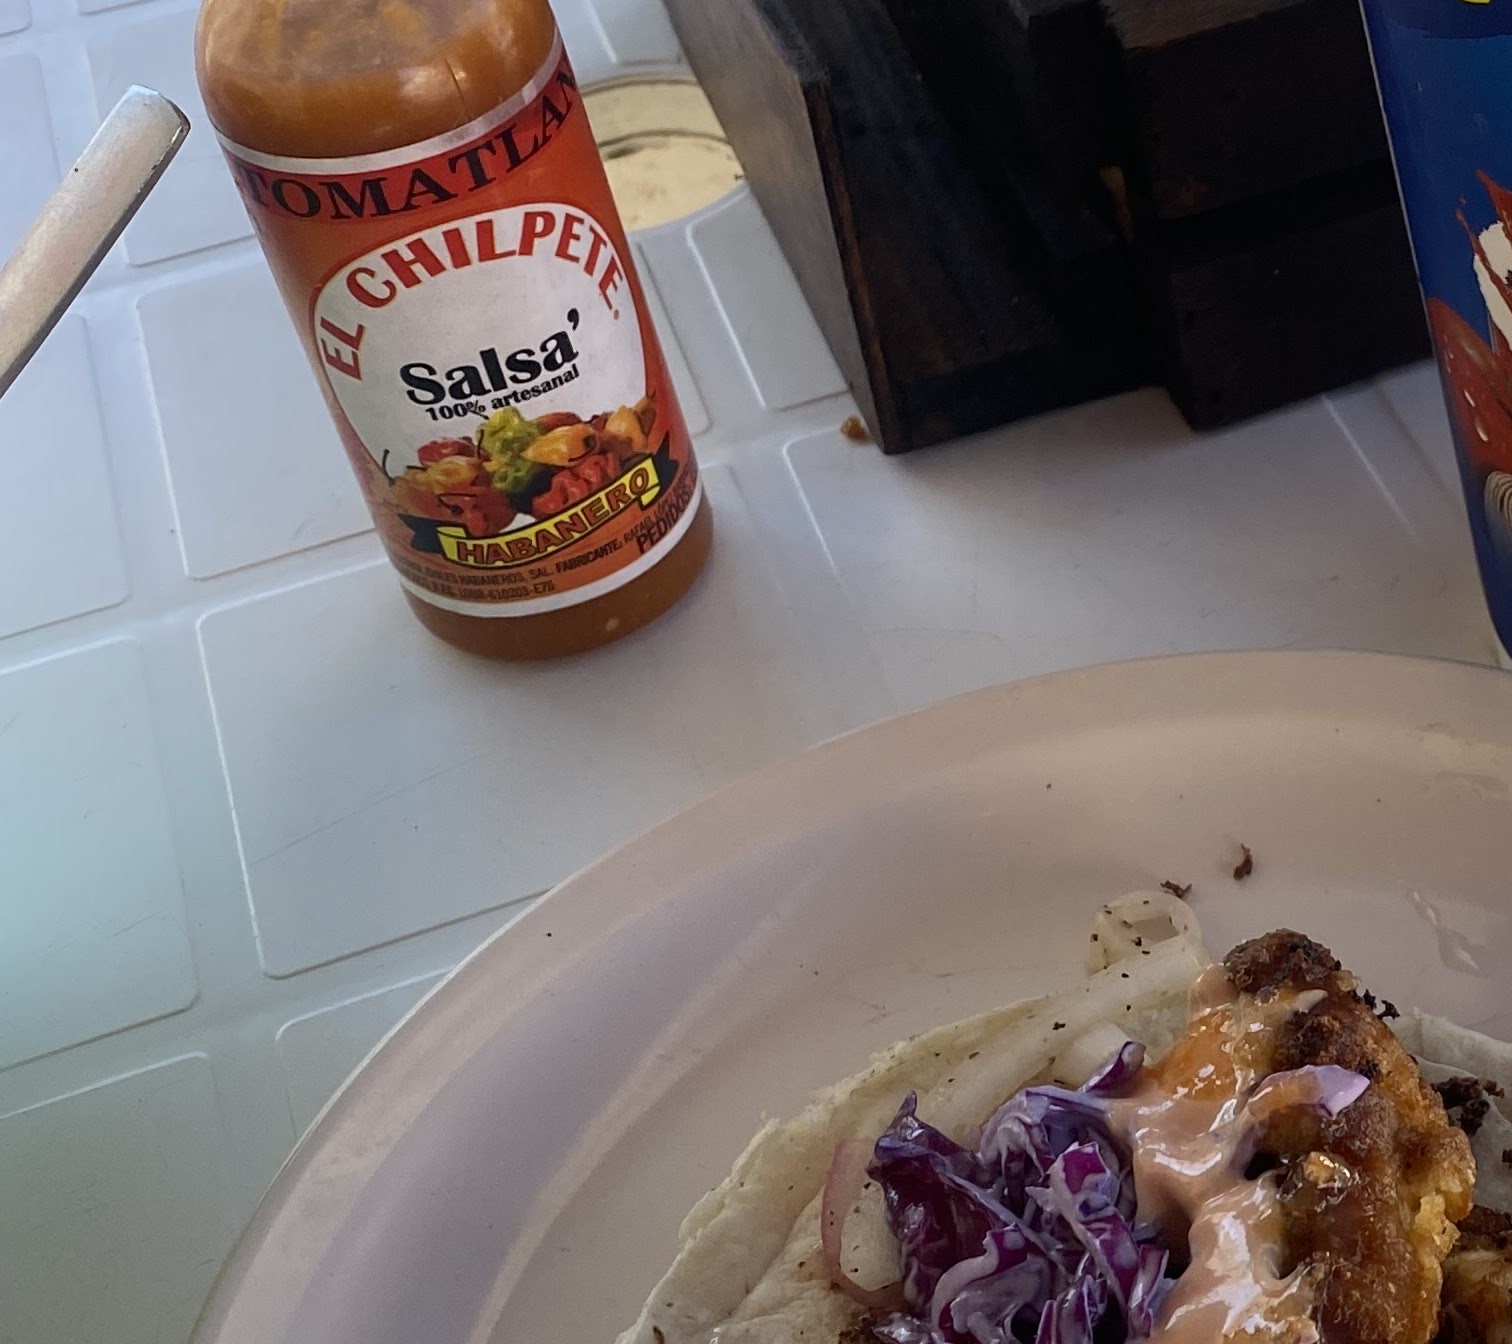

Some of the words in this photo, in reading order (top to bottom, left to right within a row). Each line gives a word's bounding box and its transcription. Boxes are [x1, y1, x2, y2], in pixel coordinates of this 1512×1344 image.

[320, 316, 365, 381] EL
[345, 211, 623, 311] CHILPETE
[425, 401, 489, 422] 100%
[491, 364, 581, 412] artesanal
[456, 467, 650, 565] HABANERO
